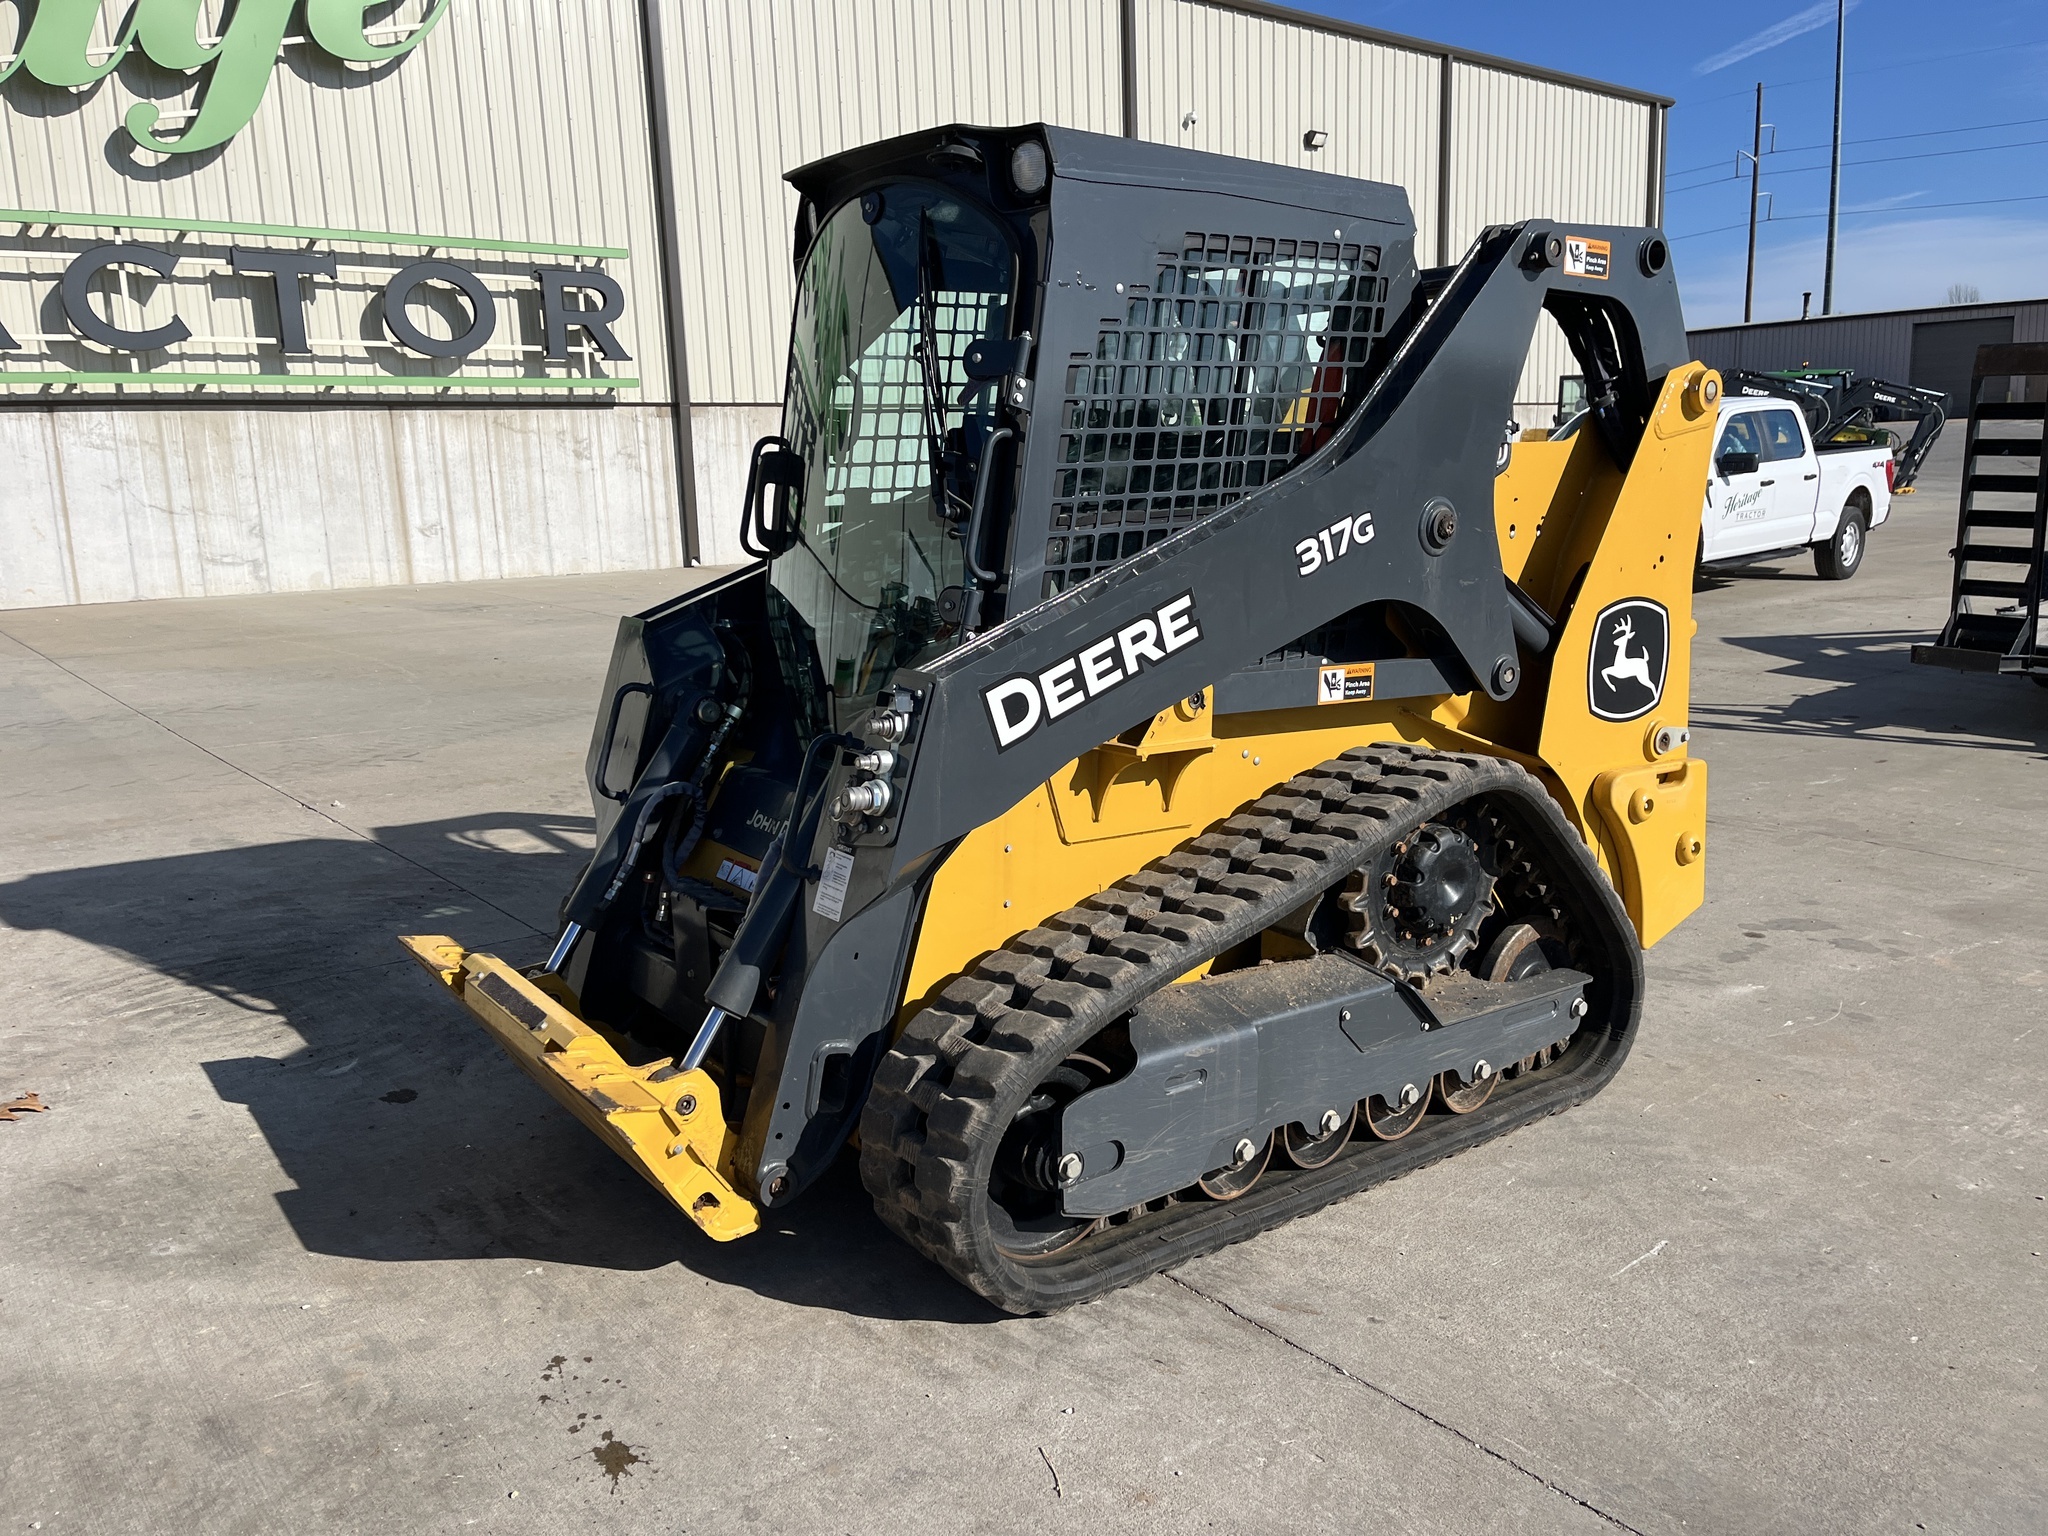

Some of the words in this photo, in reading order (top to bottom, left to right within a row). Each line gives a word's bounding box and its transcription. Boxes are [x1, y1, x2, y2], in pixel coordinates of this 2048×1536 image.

[0, 244, 633, 361] CTOR
[1873, 392, 1897, 403] DEERE
[1722, 488, 1762, 520] Heritage
[1736, 509, 1767, 521] TRACTOR
[1295, 511, 1375, 576] 317G
[984, 593, 1200, 747] DEERE
[746, 809, 781, 835] JOHN
